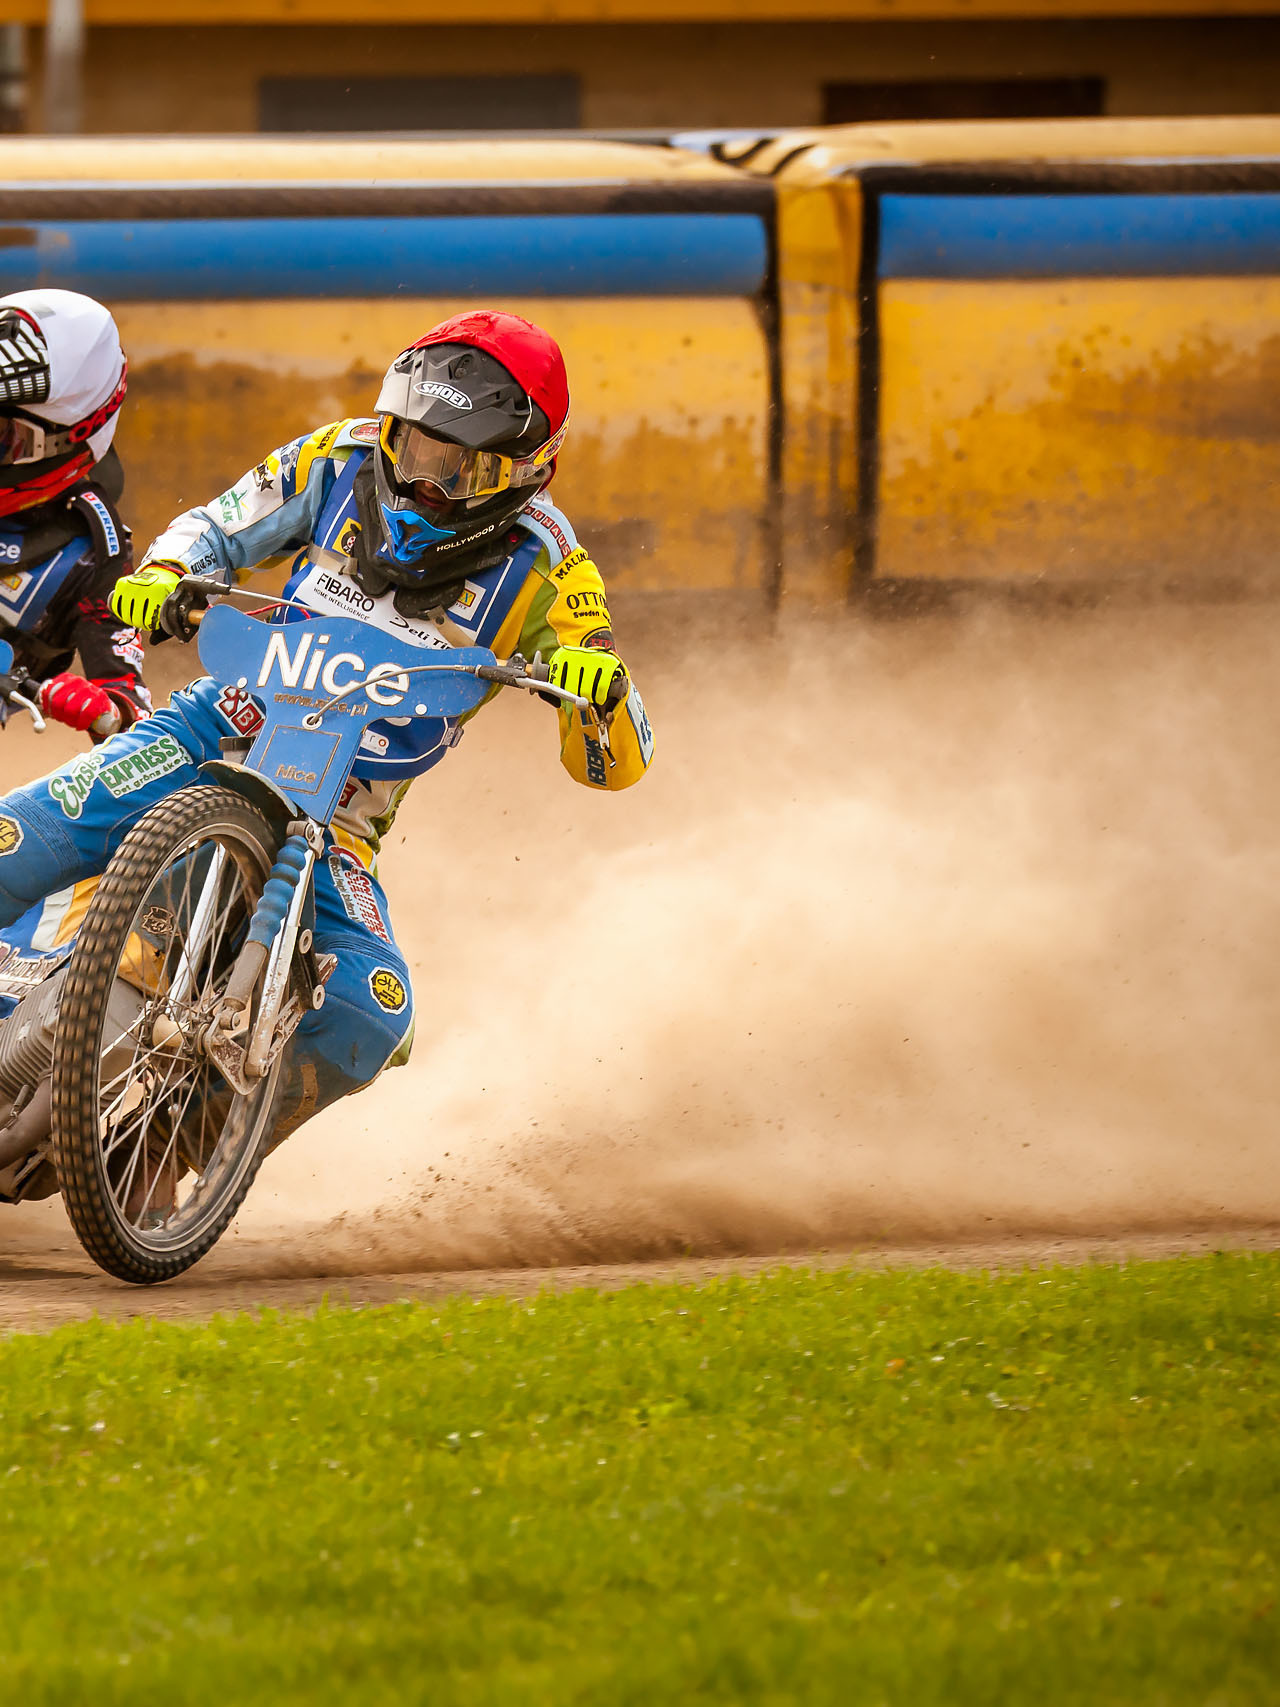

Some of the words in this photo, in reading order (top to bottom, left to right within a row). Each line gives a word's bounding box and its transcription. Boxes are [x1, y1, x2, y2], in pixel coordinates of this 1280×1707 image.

[421, 383, 467, 407] SHOEI
[94, 502, 118, 554] BERNER
[436, 524, 495, 552] HOLLYWOOD
[524, 506, 571, 558] AUHAUS
[313, 588, 328, 600] HOME
[328, 595, 371, 621] INTELLIGENCE
[316, 572, 376, 613] FIBARO
[573, 610, 600, 619] Sweden
[256, 631, 411, 707] Nice
[99, 737, 179, 789] EXPRESS
[275, 764, 318, 784] Nice
[113, 784, 132, 796] Det
